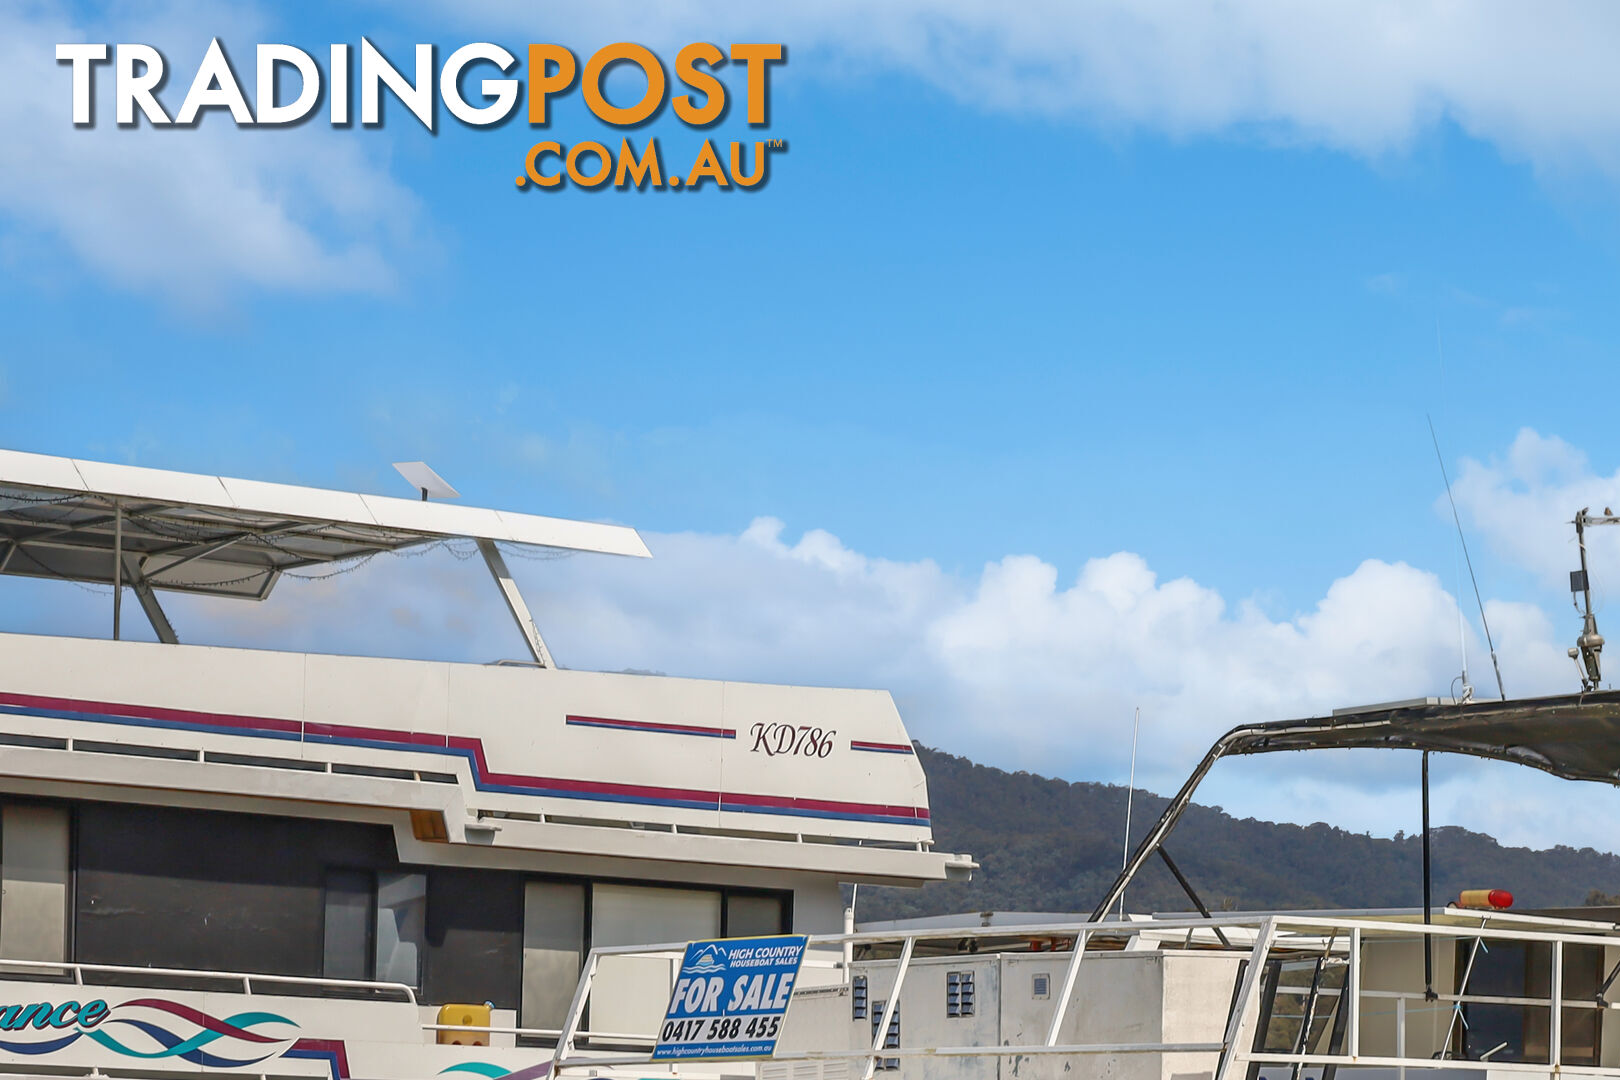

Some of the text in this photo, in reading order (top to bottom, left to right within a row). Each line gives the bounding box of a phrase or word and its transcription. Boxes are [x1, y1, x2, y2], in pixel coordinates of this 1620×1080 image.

[750, 722, 837, 759] KD786
[728, 944, 804, 960] HIGH COUNTRY
[729, 956, 798, 968] HOUSEBOAT SALES
[668, 972, 796, 1014] FOR SALE
[662, 1015, 782, 1042] 0417 588 455
[656, 1044, 772, 1057] www.highcountryhouseboatsales.com.au
